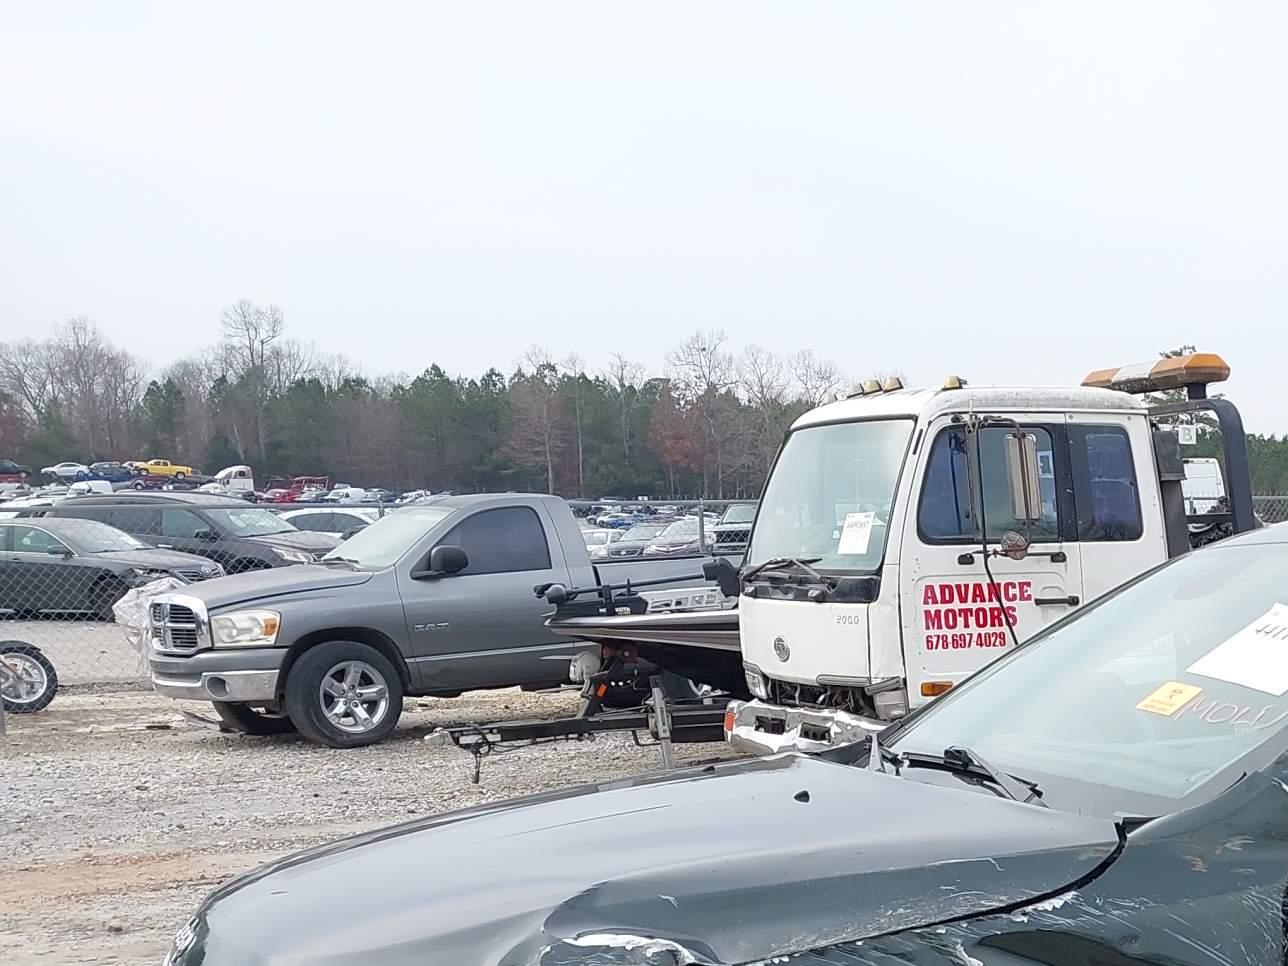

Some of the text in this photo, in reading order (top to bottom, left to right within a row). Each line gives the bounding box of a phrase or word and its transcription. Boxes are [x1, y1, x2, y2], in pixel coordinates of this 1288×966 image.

[922, 581, 1033, 605] ADVANCE
[923, 606, 1018, 631] MOTORS
[925, 631, 1007, 650] 678-697-4029
